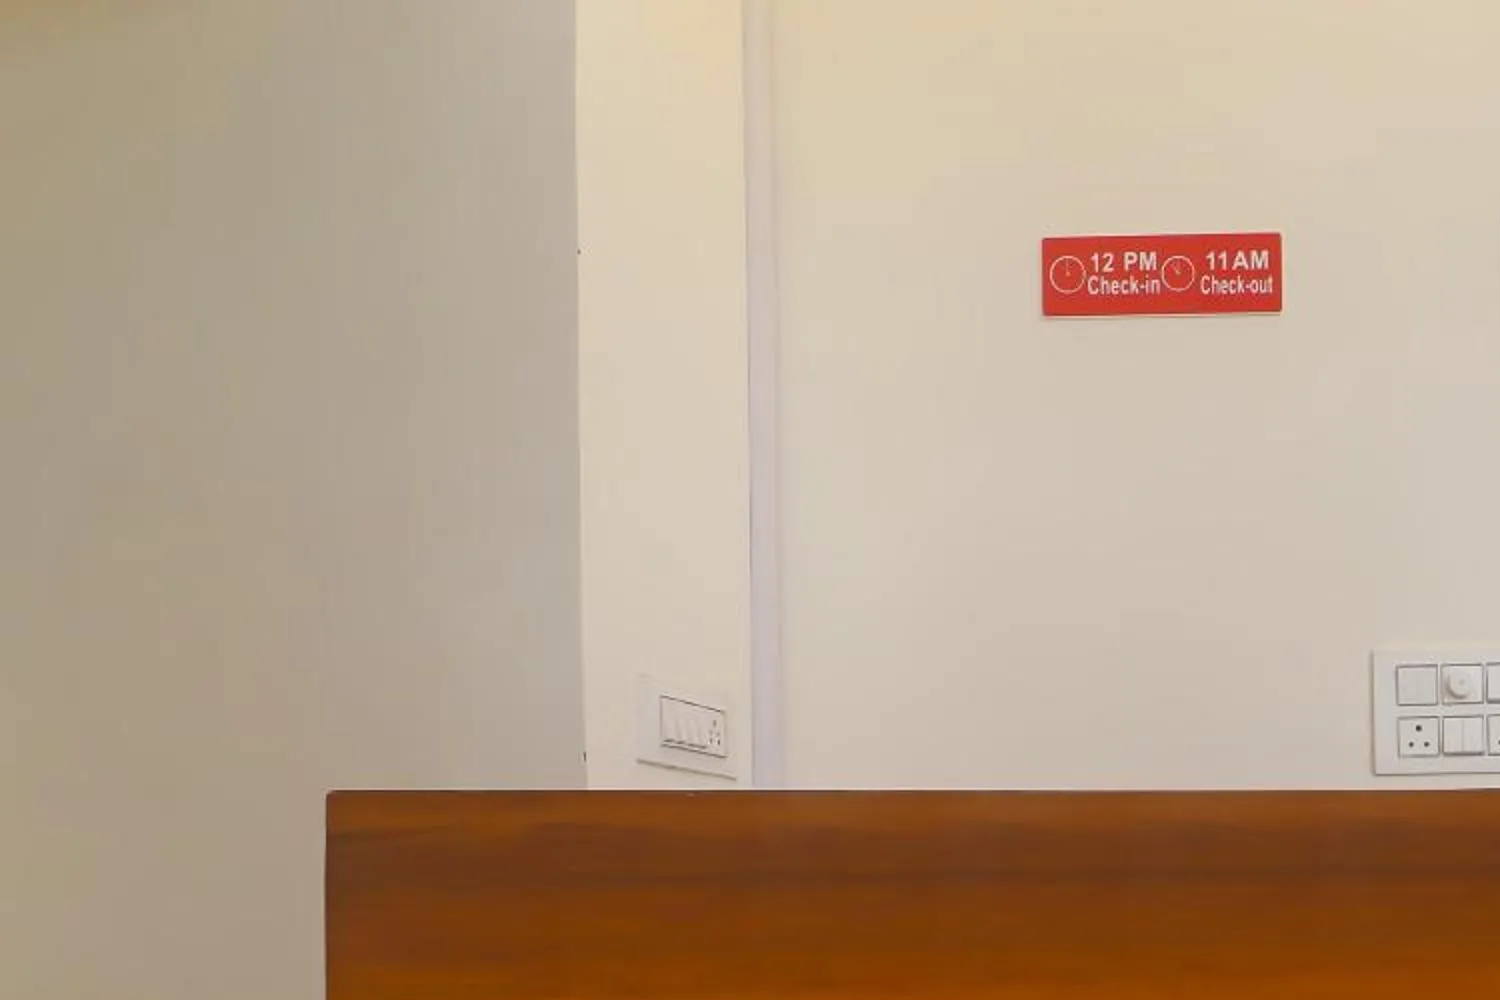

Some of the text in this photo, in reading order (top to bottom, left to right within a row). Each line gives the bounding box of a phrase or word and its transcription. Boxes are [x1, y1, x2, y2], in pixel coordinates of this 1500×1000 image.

[1091, 251, 1158, 272] 12 PM
[1087, 275, 1161, 295] Check-in
[1200, 274, 1274, 295] Check-out
